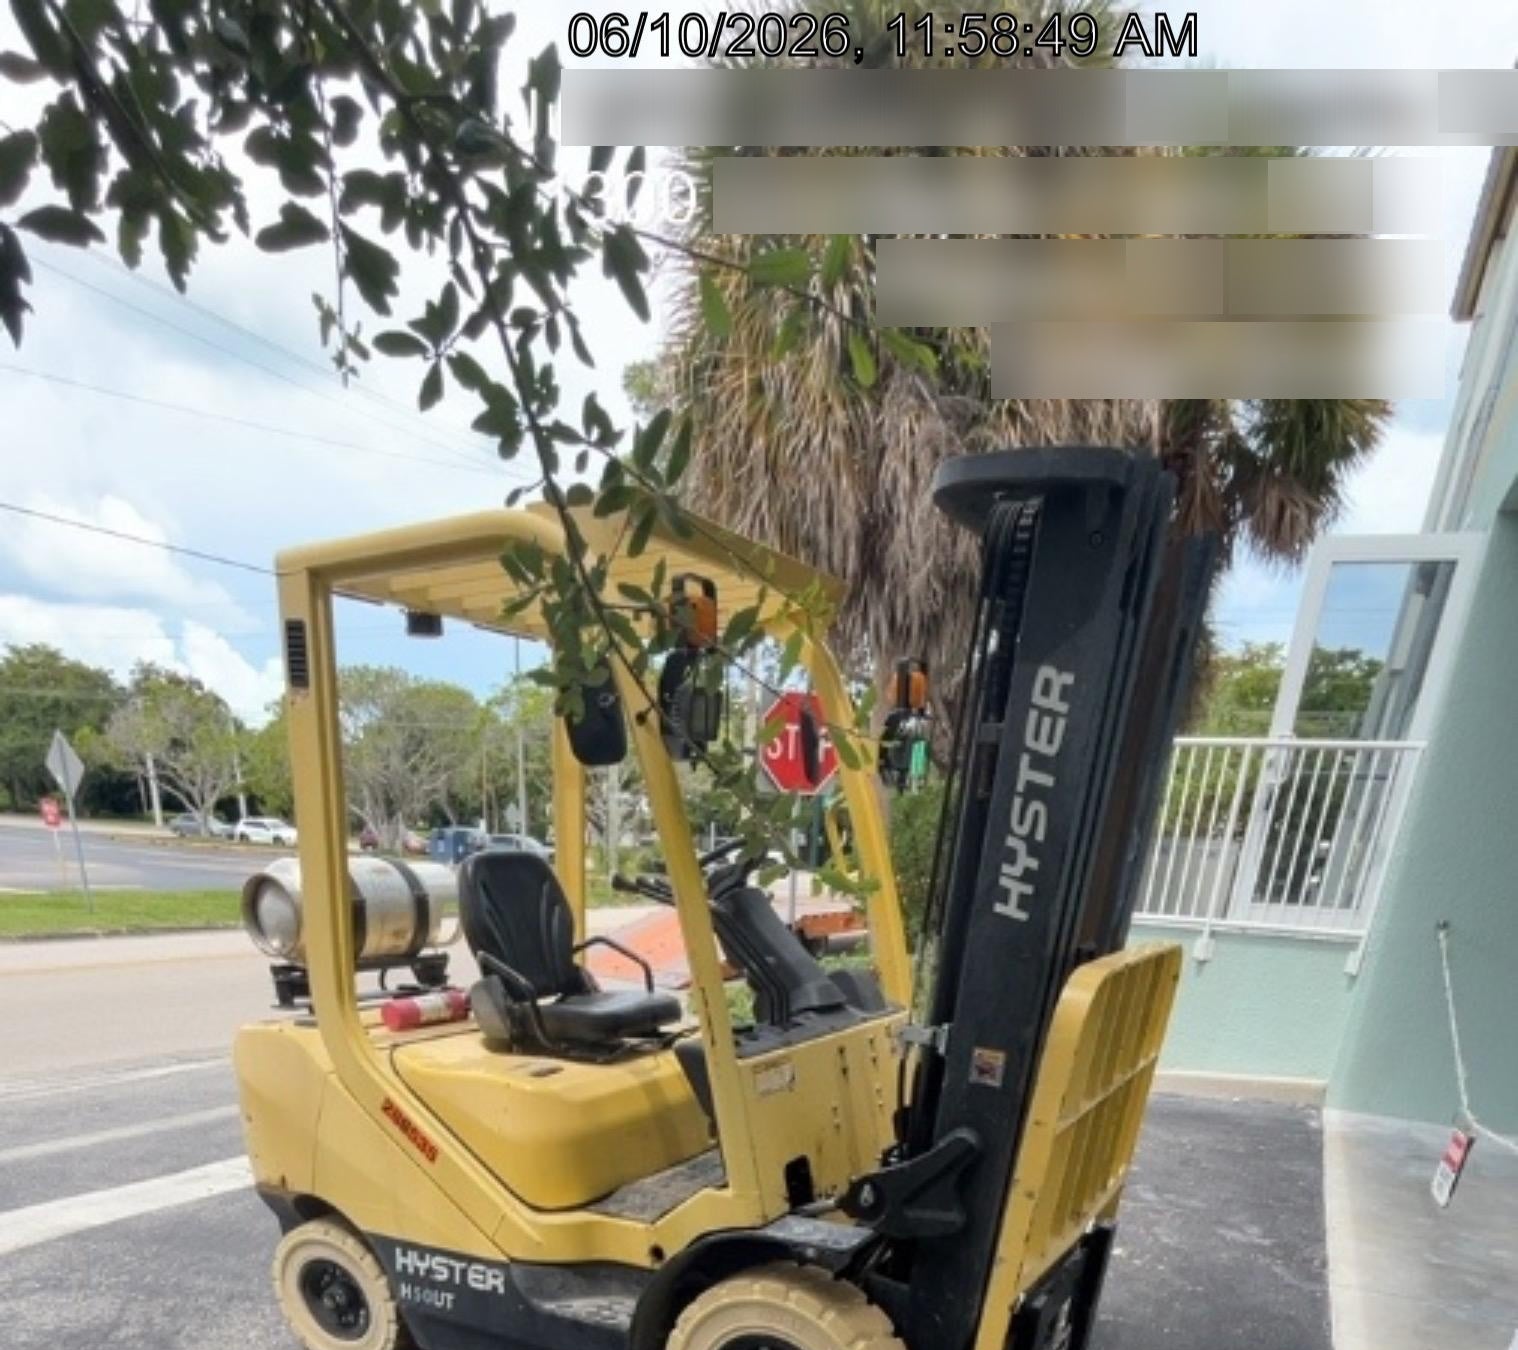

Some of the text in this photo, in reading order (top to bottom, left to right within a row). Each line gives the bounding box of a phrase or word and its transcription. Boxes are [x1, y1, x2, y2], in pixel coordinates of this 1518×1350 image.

[766, 723, 834, 763] STP
[993, 664, 1075, 922] HYSTER
[395, 1246, 505, 1296] HYSTER
